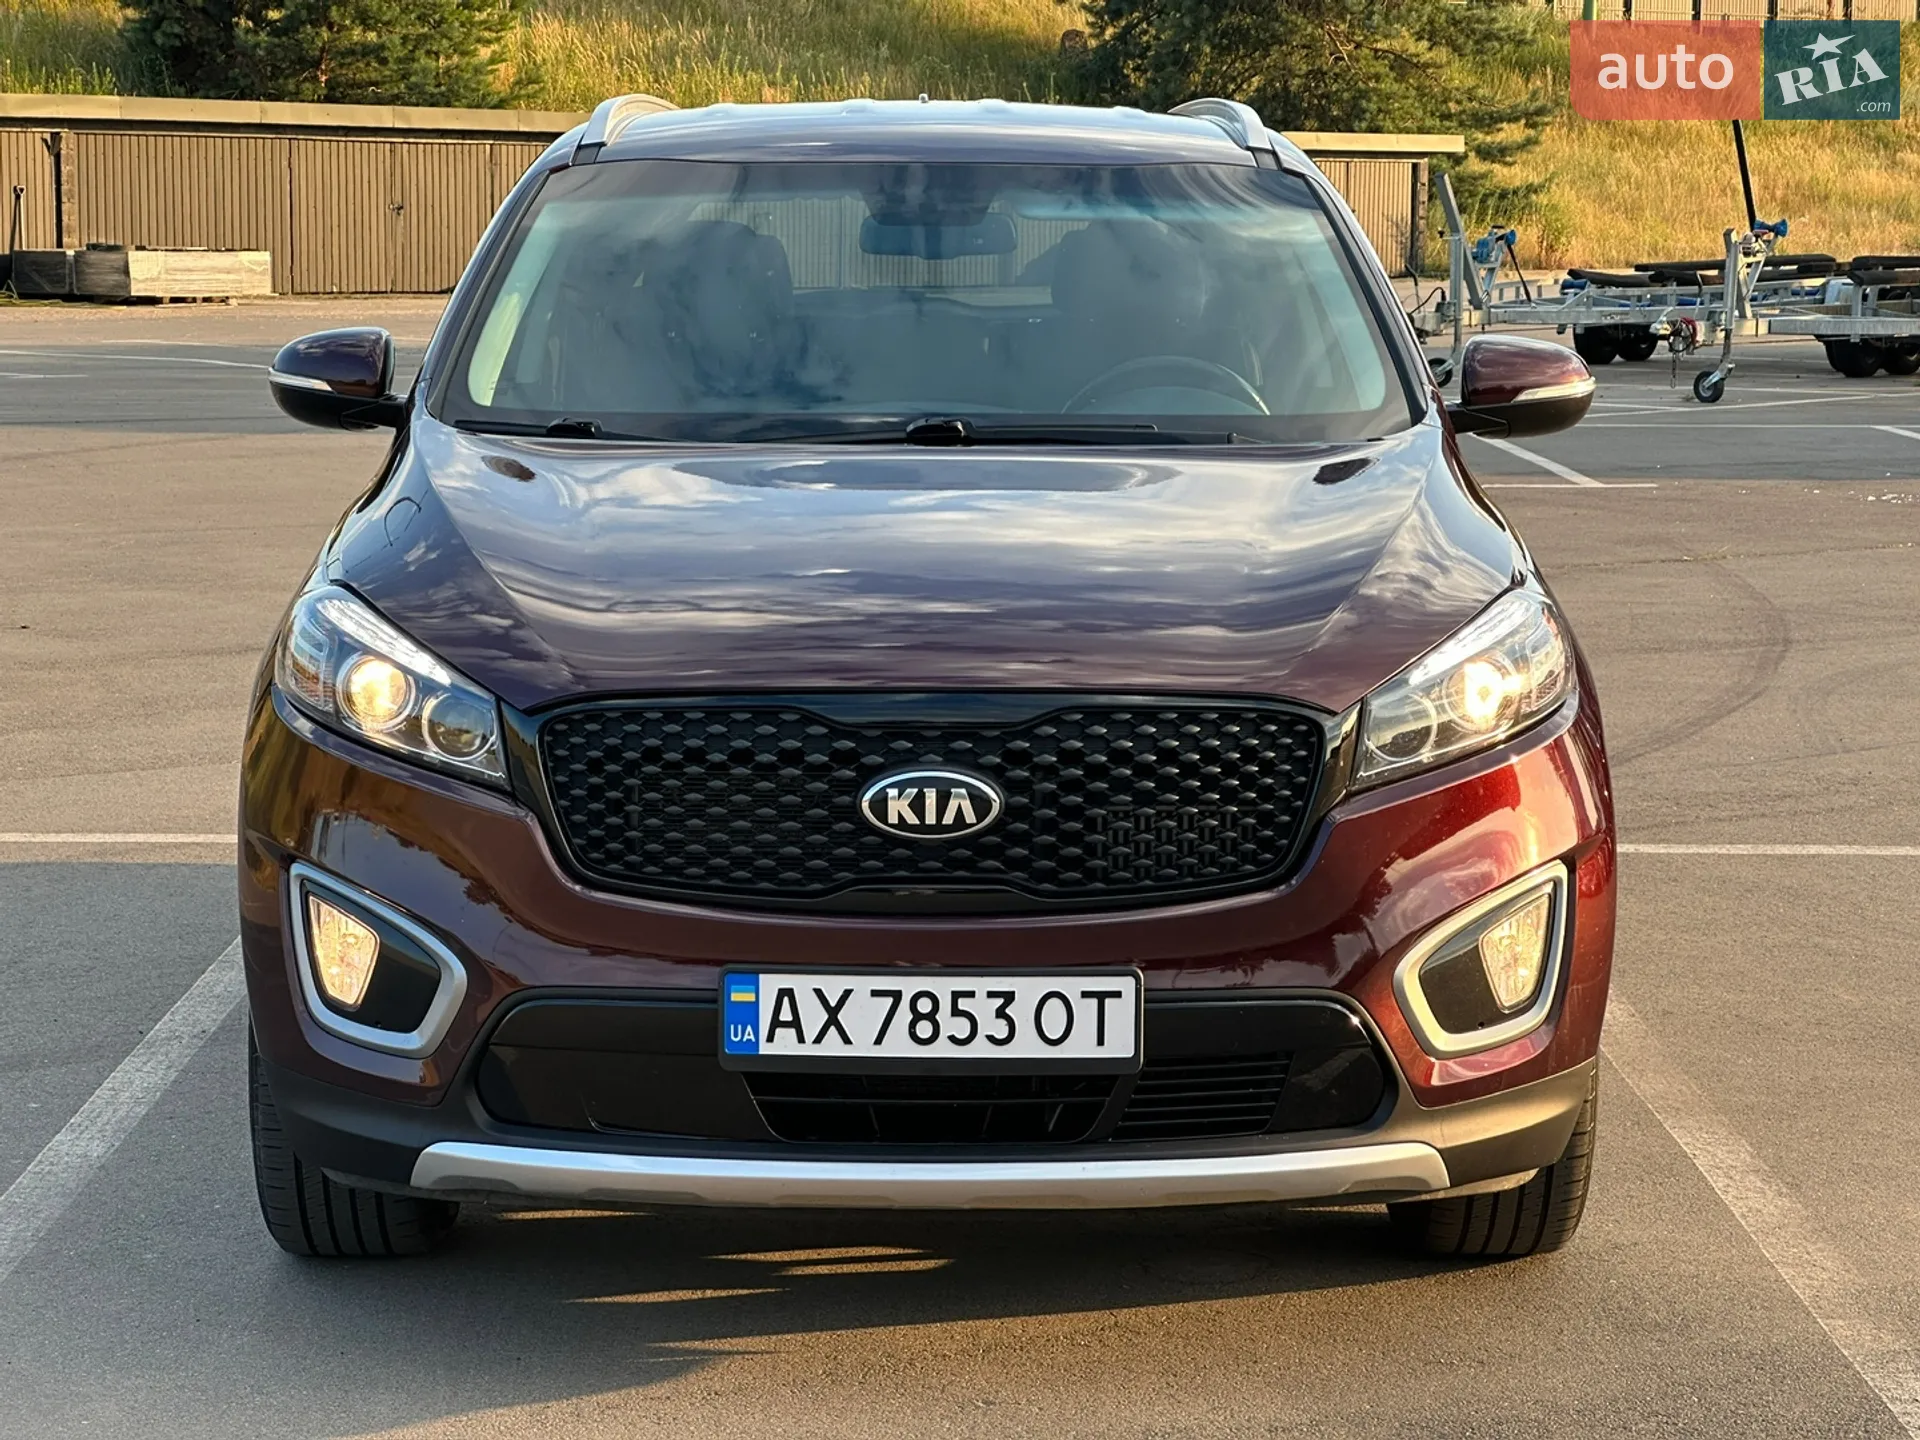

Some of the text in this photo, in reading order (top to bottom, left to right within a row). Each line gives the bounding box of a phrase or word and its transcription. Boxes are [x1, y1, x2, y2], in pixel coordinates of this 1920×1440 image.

[886, 788, 977, 824] KIA
[730, 1023, 756, 1042] UA
[765, 987, 1123, 1047] AX 7853 OT
